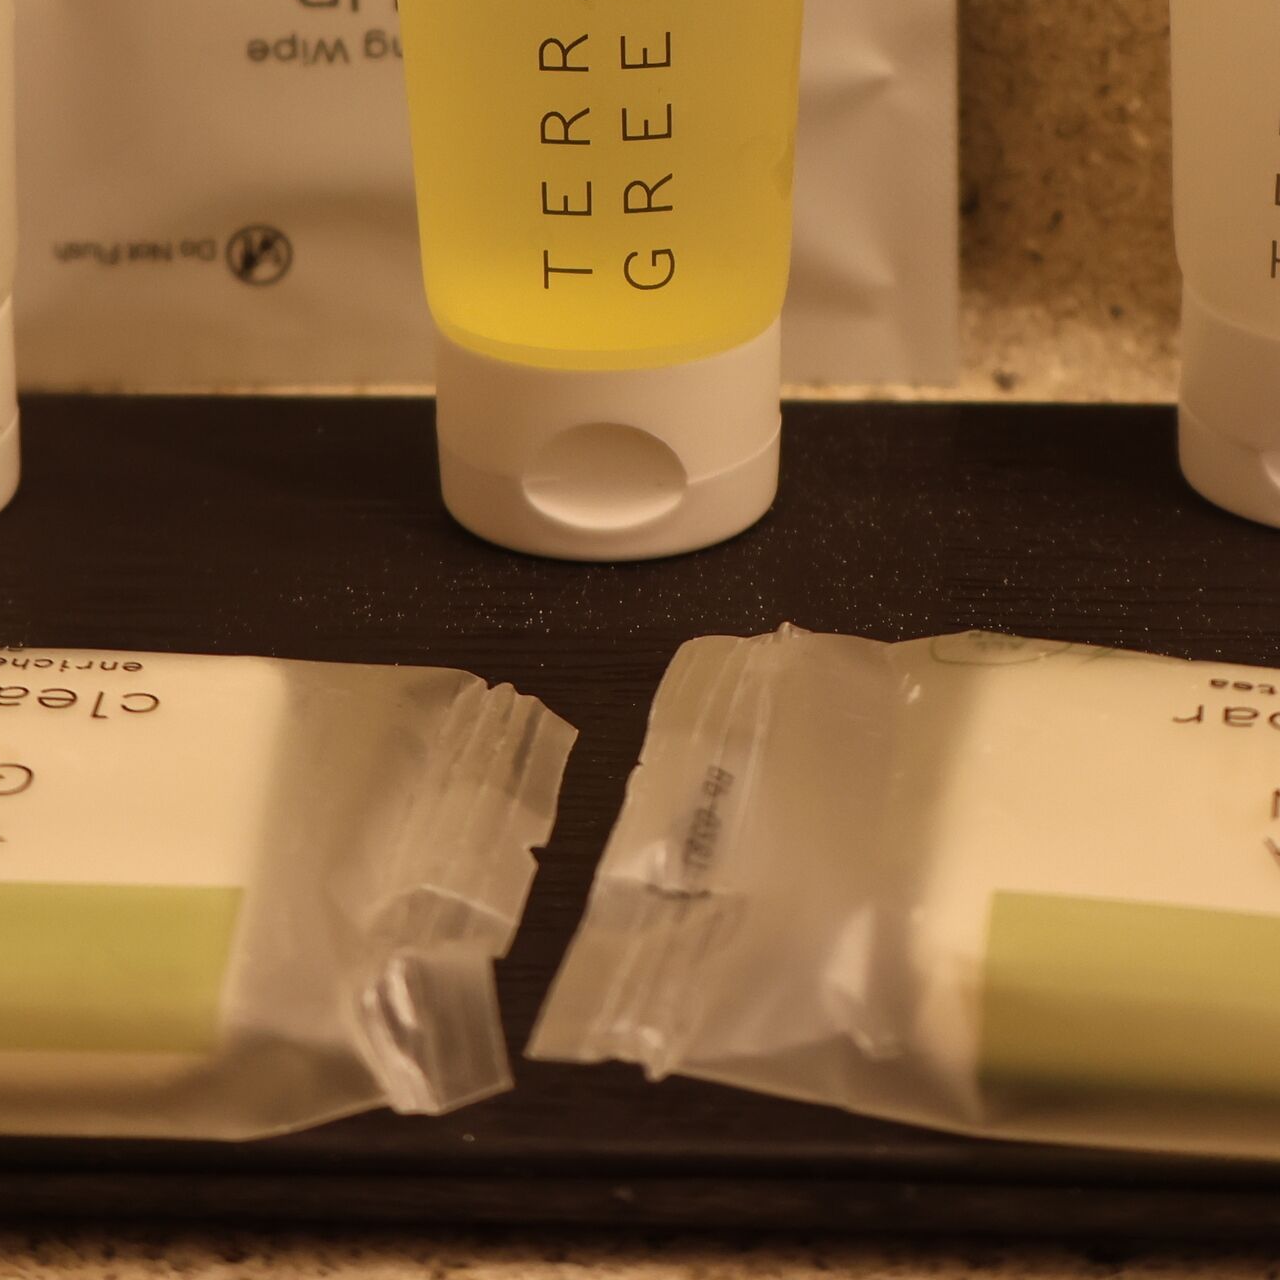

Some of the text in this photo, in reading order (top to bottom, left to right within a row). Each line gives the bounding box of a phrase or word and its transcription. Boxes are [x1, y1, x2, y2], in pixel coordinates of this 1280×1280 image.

[247, 33, 349, 66] Wipe
[55, 240, 216, 266] Do Not Flush
[1208, 678, 1275, 695] tea
